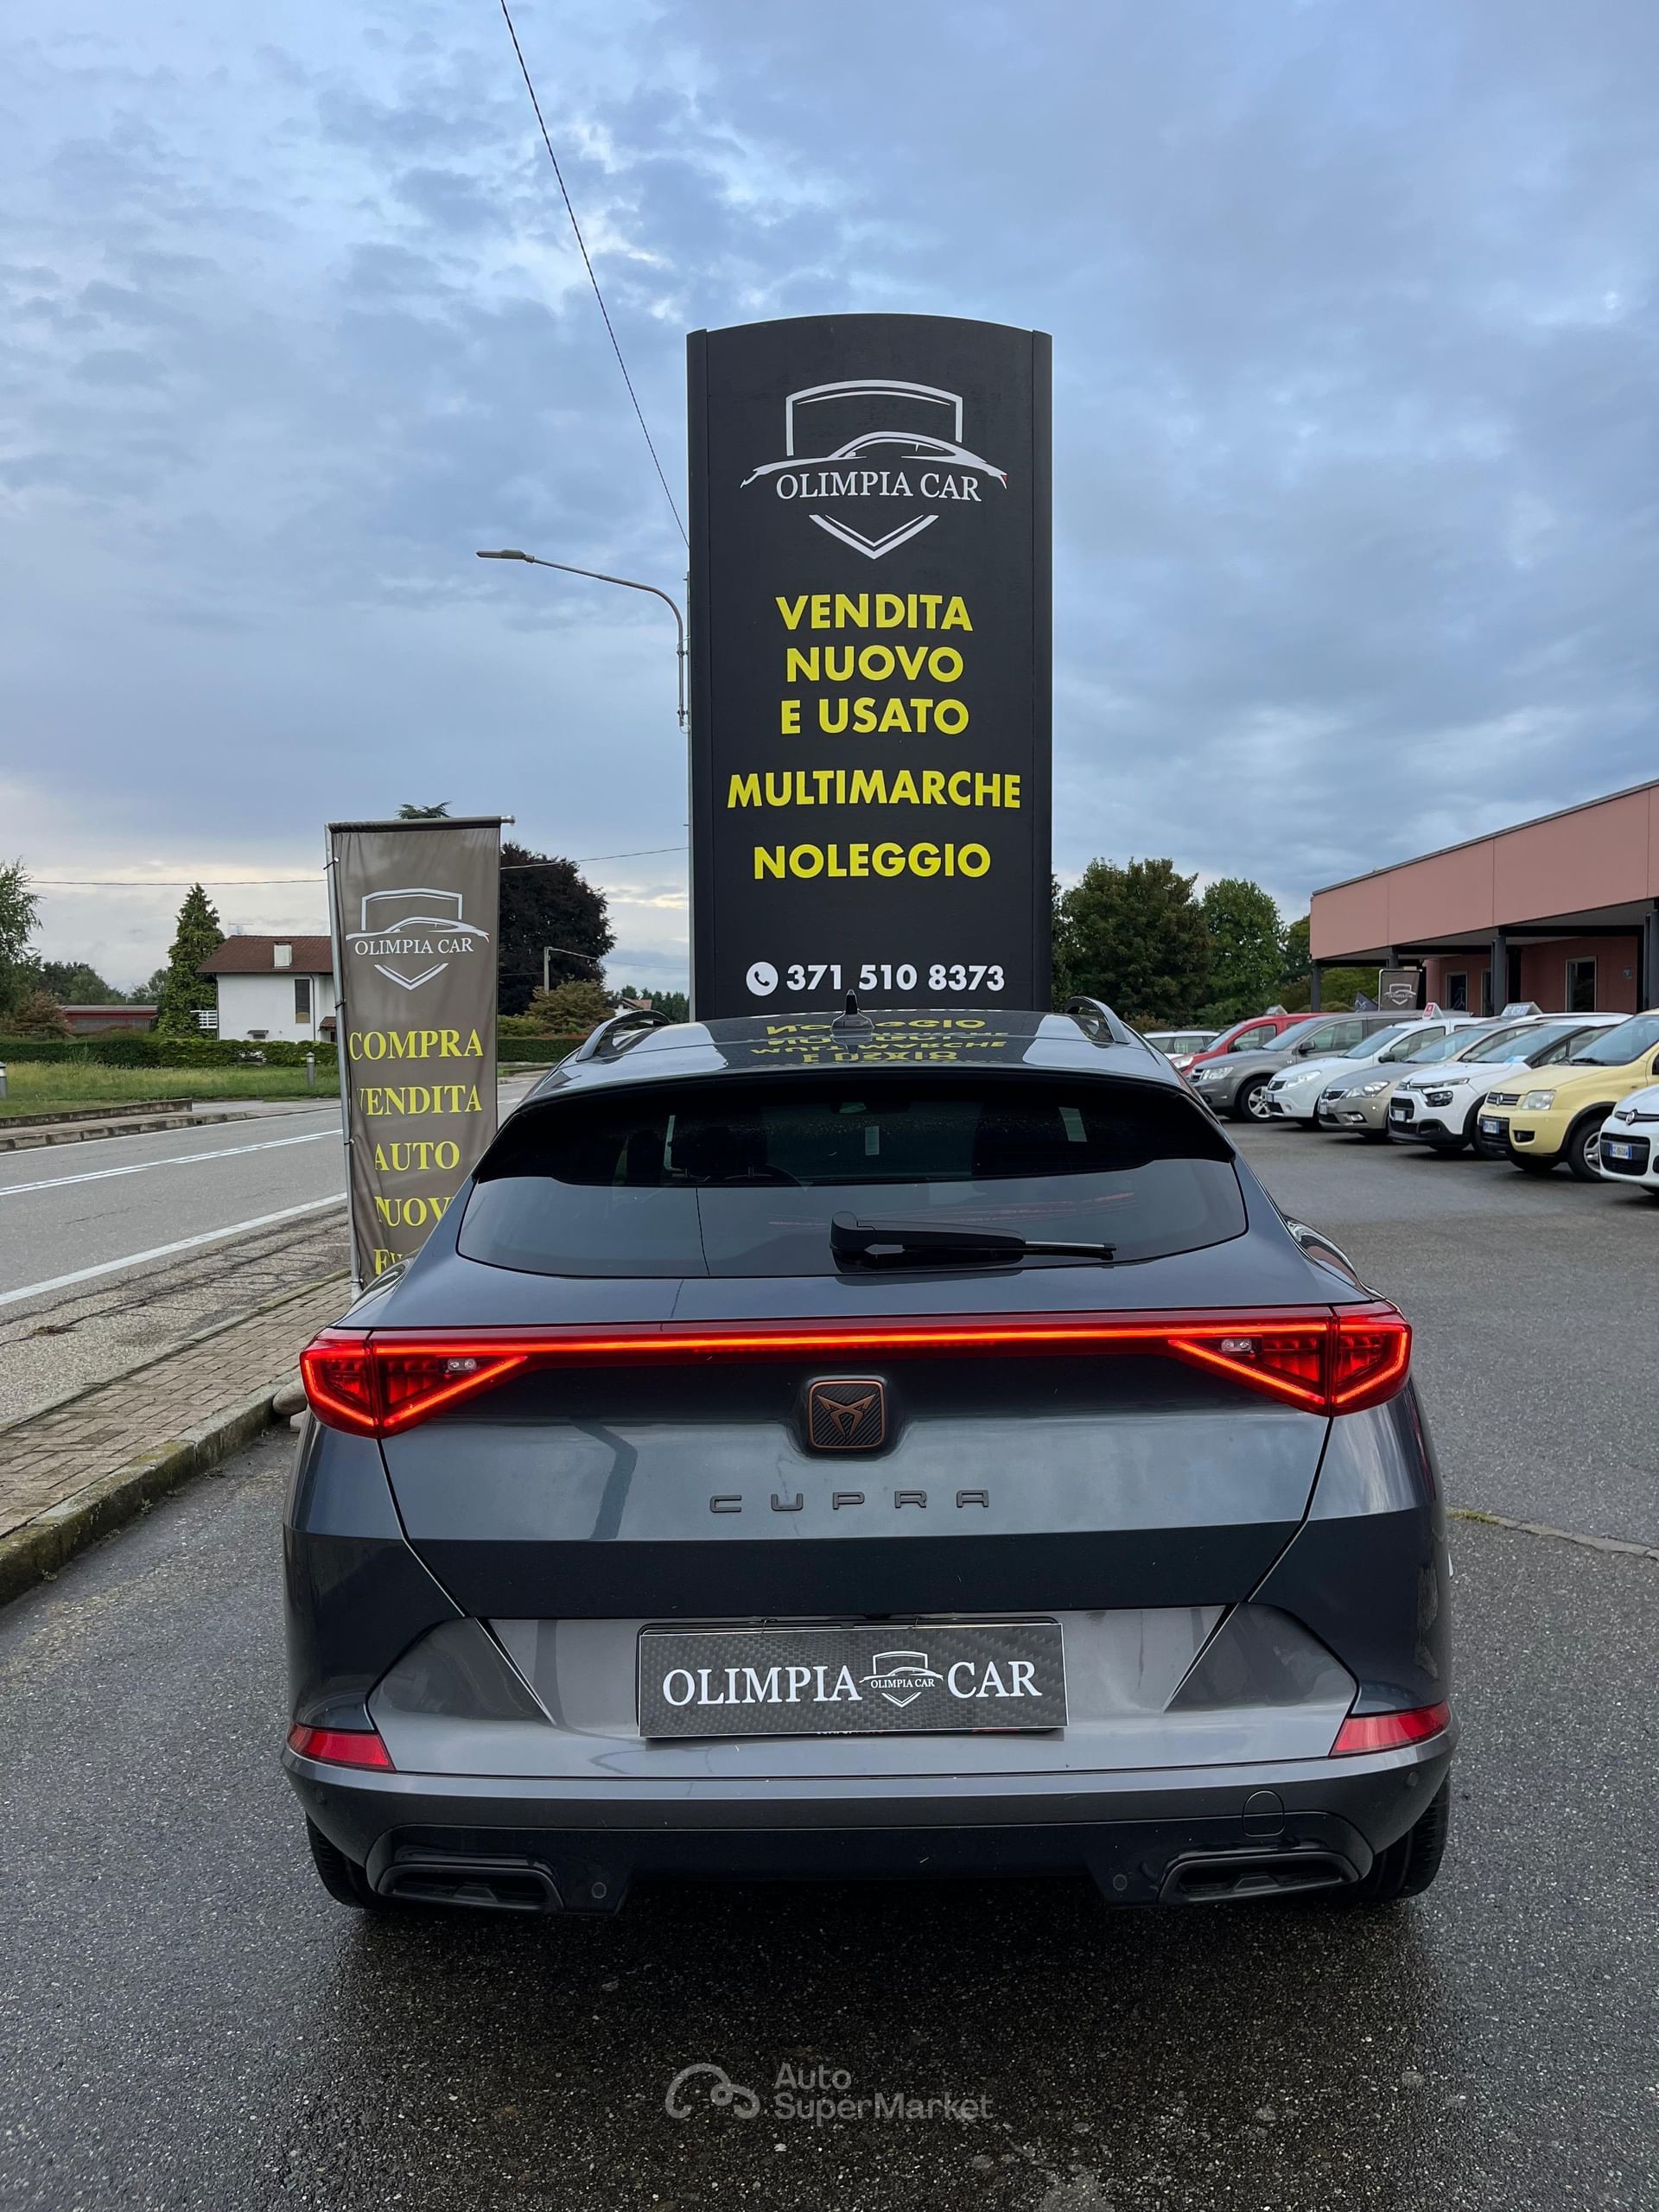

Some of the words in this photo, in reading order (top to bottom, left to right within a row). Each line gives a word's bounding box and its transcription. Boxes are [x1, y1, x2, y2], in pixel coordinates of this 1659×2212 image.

[776, 472, 912, 499] OLIMPIA
[920, 473, 982, 502] CAR
[776, 594, 973, 632] VENDITA
[786, 645, 963, 683] NUOVO
[781, 699, 801, 734] E
[818, 697, 969, 734] USATO
[727, 769, 1021, 809] MULTIMARCHE
[753, 842, 991, 880] NOLEGGIO
[354, 939, 434, 956] OLIMPIA
[437, 938, 474, 954] CAR
[786, 964, 842, 991] 371
[858, 964, 918, 991] 510
[928, 964, 1005, 991] 8373
[349, 1029, 484, 1061] COMPRA
[375, 1141, 461, 1172] AUTO
[709, 1490, 989, 1513] CUPRA
[663, 1664, 863, 1706] OLIMPIA
[947, 1661, 1043, 1699] CAR
[870, 1679, 913, 1688] OLIMPIA
[914, 1678, 936, 1688] CAR
